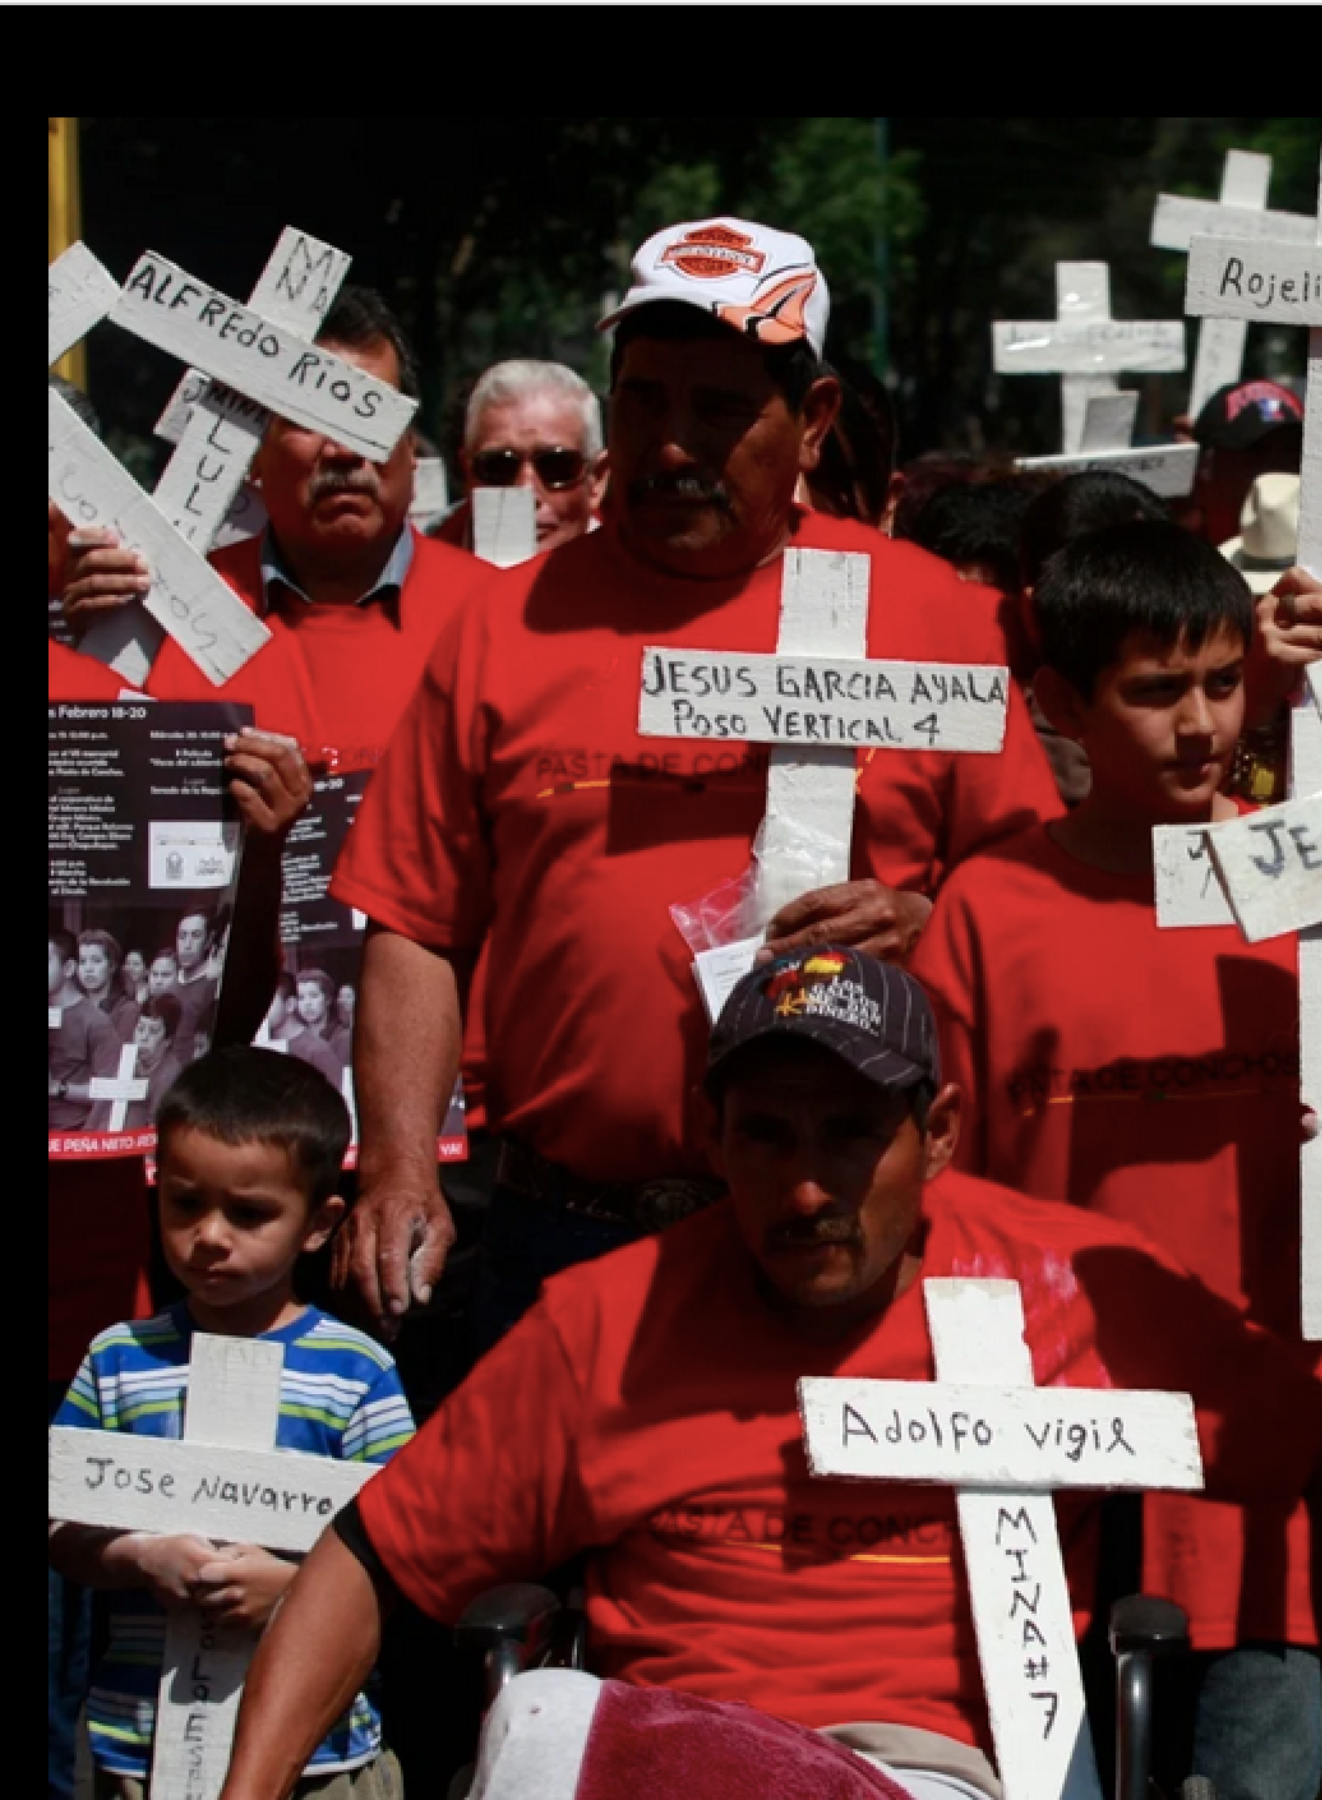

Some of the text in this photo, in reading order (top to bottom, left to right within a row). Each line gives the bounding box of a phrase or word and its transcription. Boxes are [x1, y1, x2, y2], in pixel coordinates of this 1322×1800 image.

[642, 655, 1006, 704] JESUS GARCIA AYALA
[762, 706, 902, 743] VERTICAL
[914, 713, 939, 746] 4
[692, 752, 767, 776] CON
[842, 1403, 993, 1452] Adolfo
[85, 1457, 333, 1516] Jose Navarro
